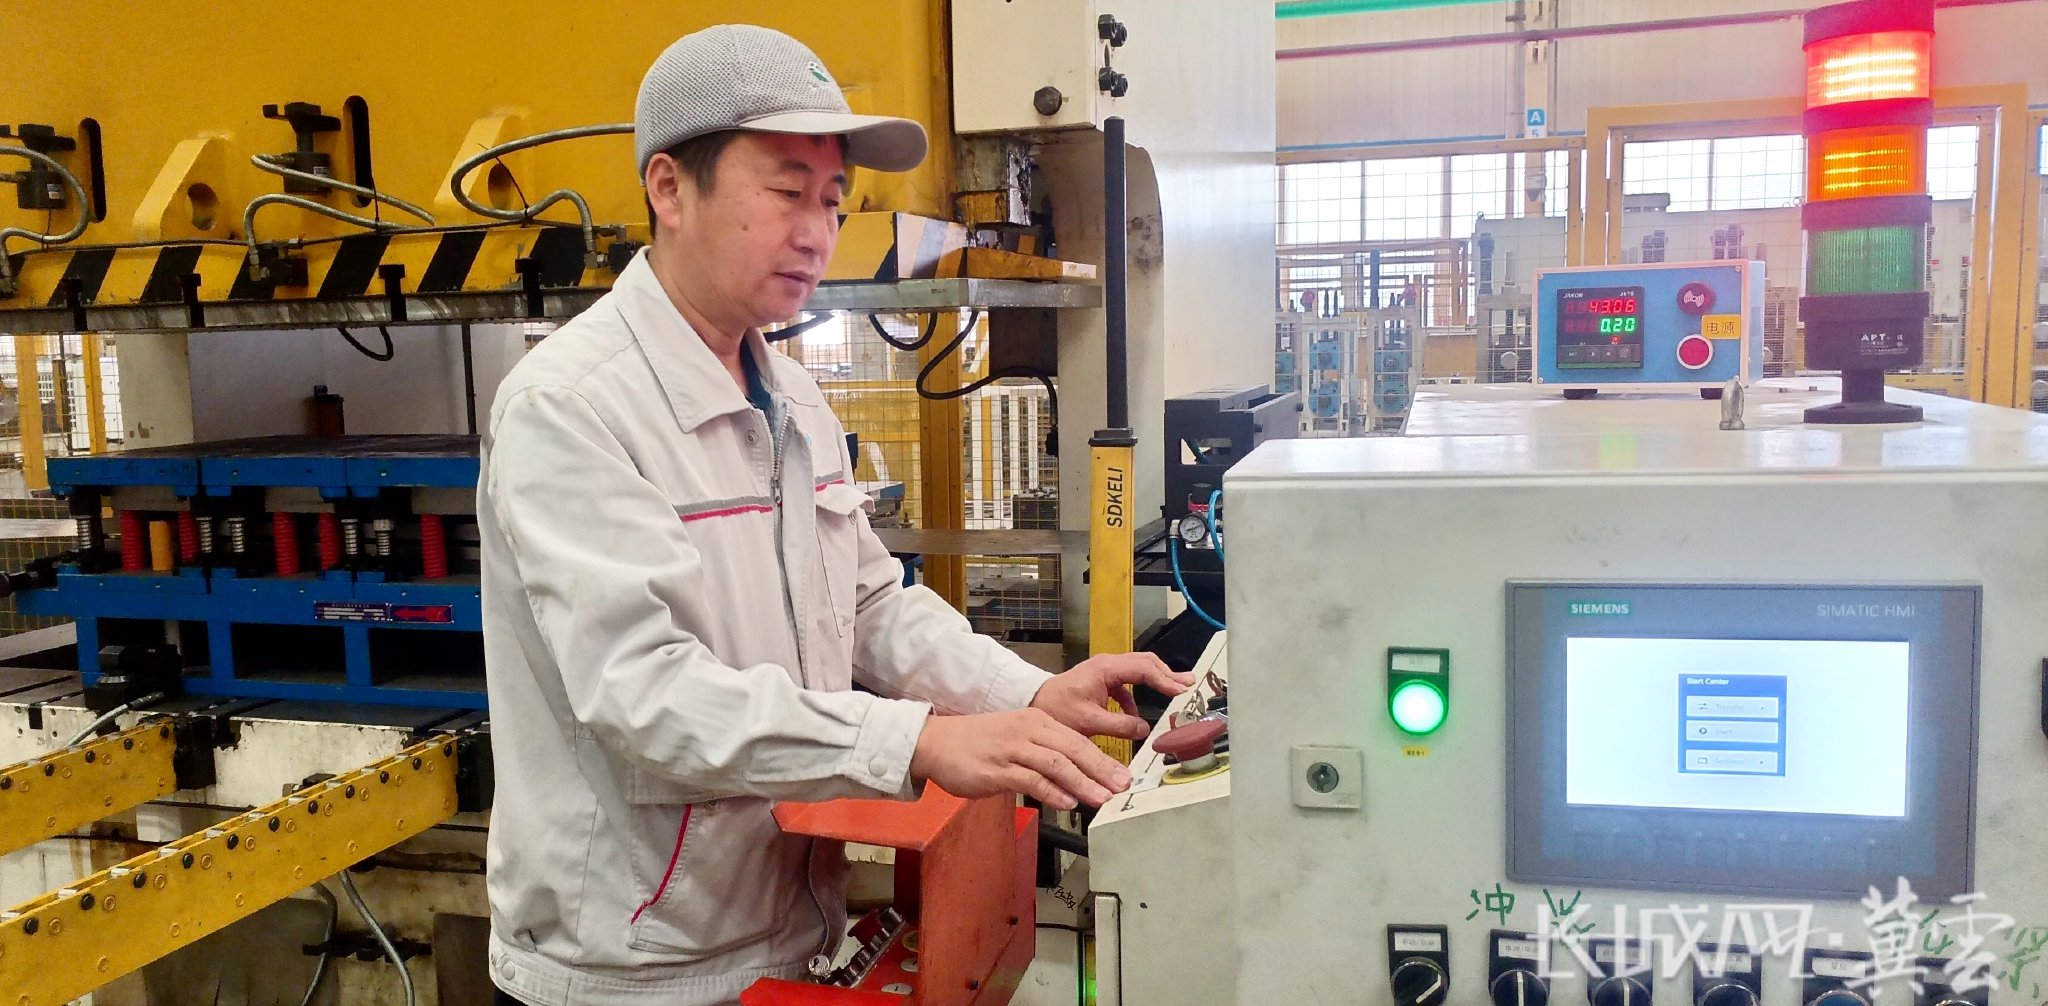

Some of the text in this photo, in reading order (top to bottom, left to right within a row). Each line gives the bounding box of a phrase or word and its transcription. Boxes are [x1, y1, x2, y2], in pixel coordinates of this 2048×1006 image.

[1530, 111, 1541, 123] A
[1600, 318, 1636, 333] 0.20
[1706, 321, 1735, 335] 电源
[1107, 467, 1123, 528] SDKELI
[1570, 603, 1630, 614] SIEMENS
[1817, 604, 1915, 617] SIMATIC HMI
[1686, 677, 1730, 686] Start Center
